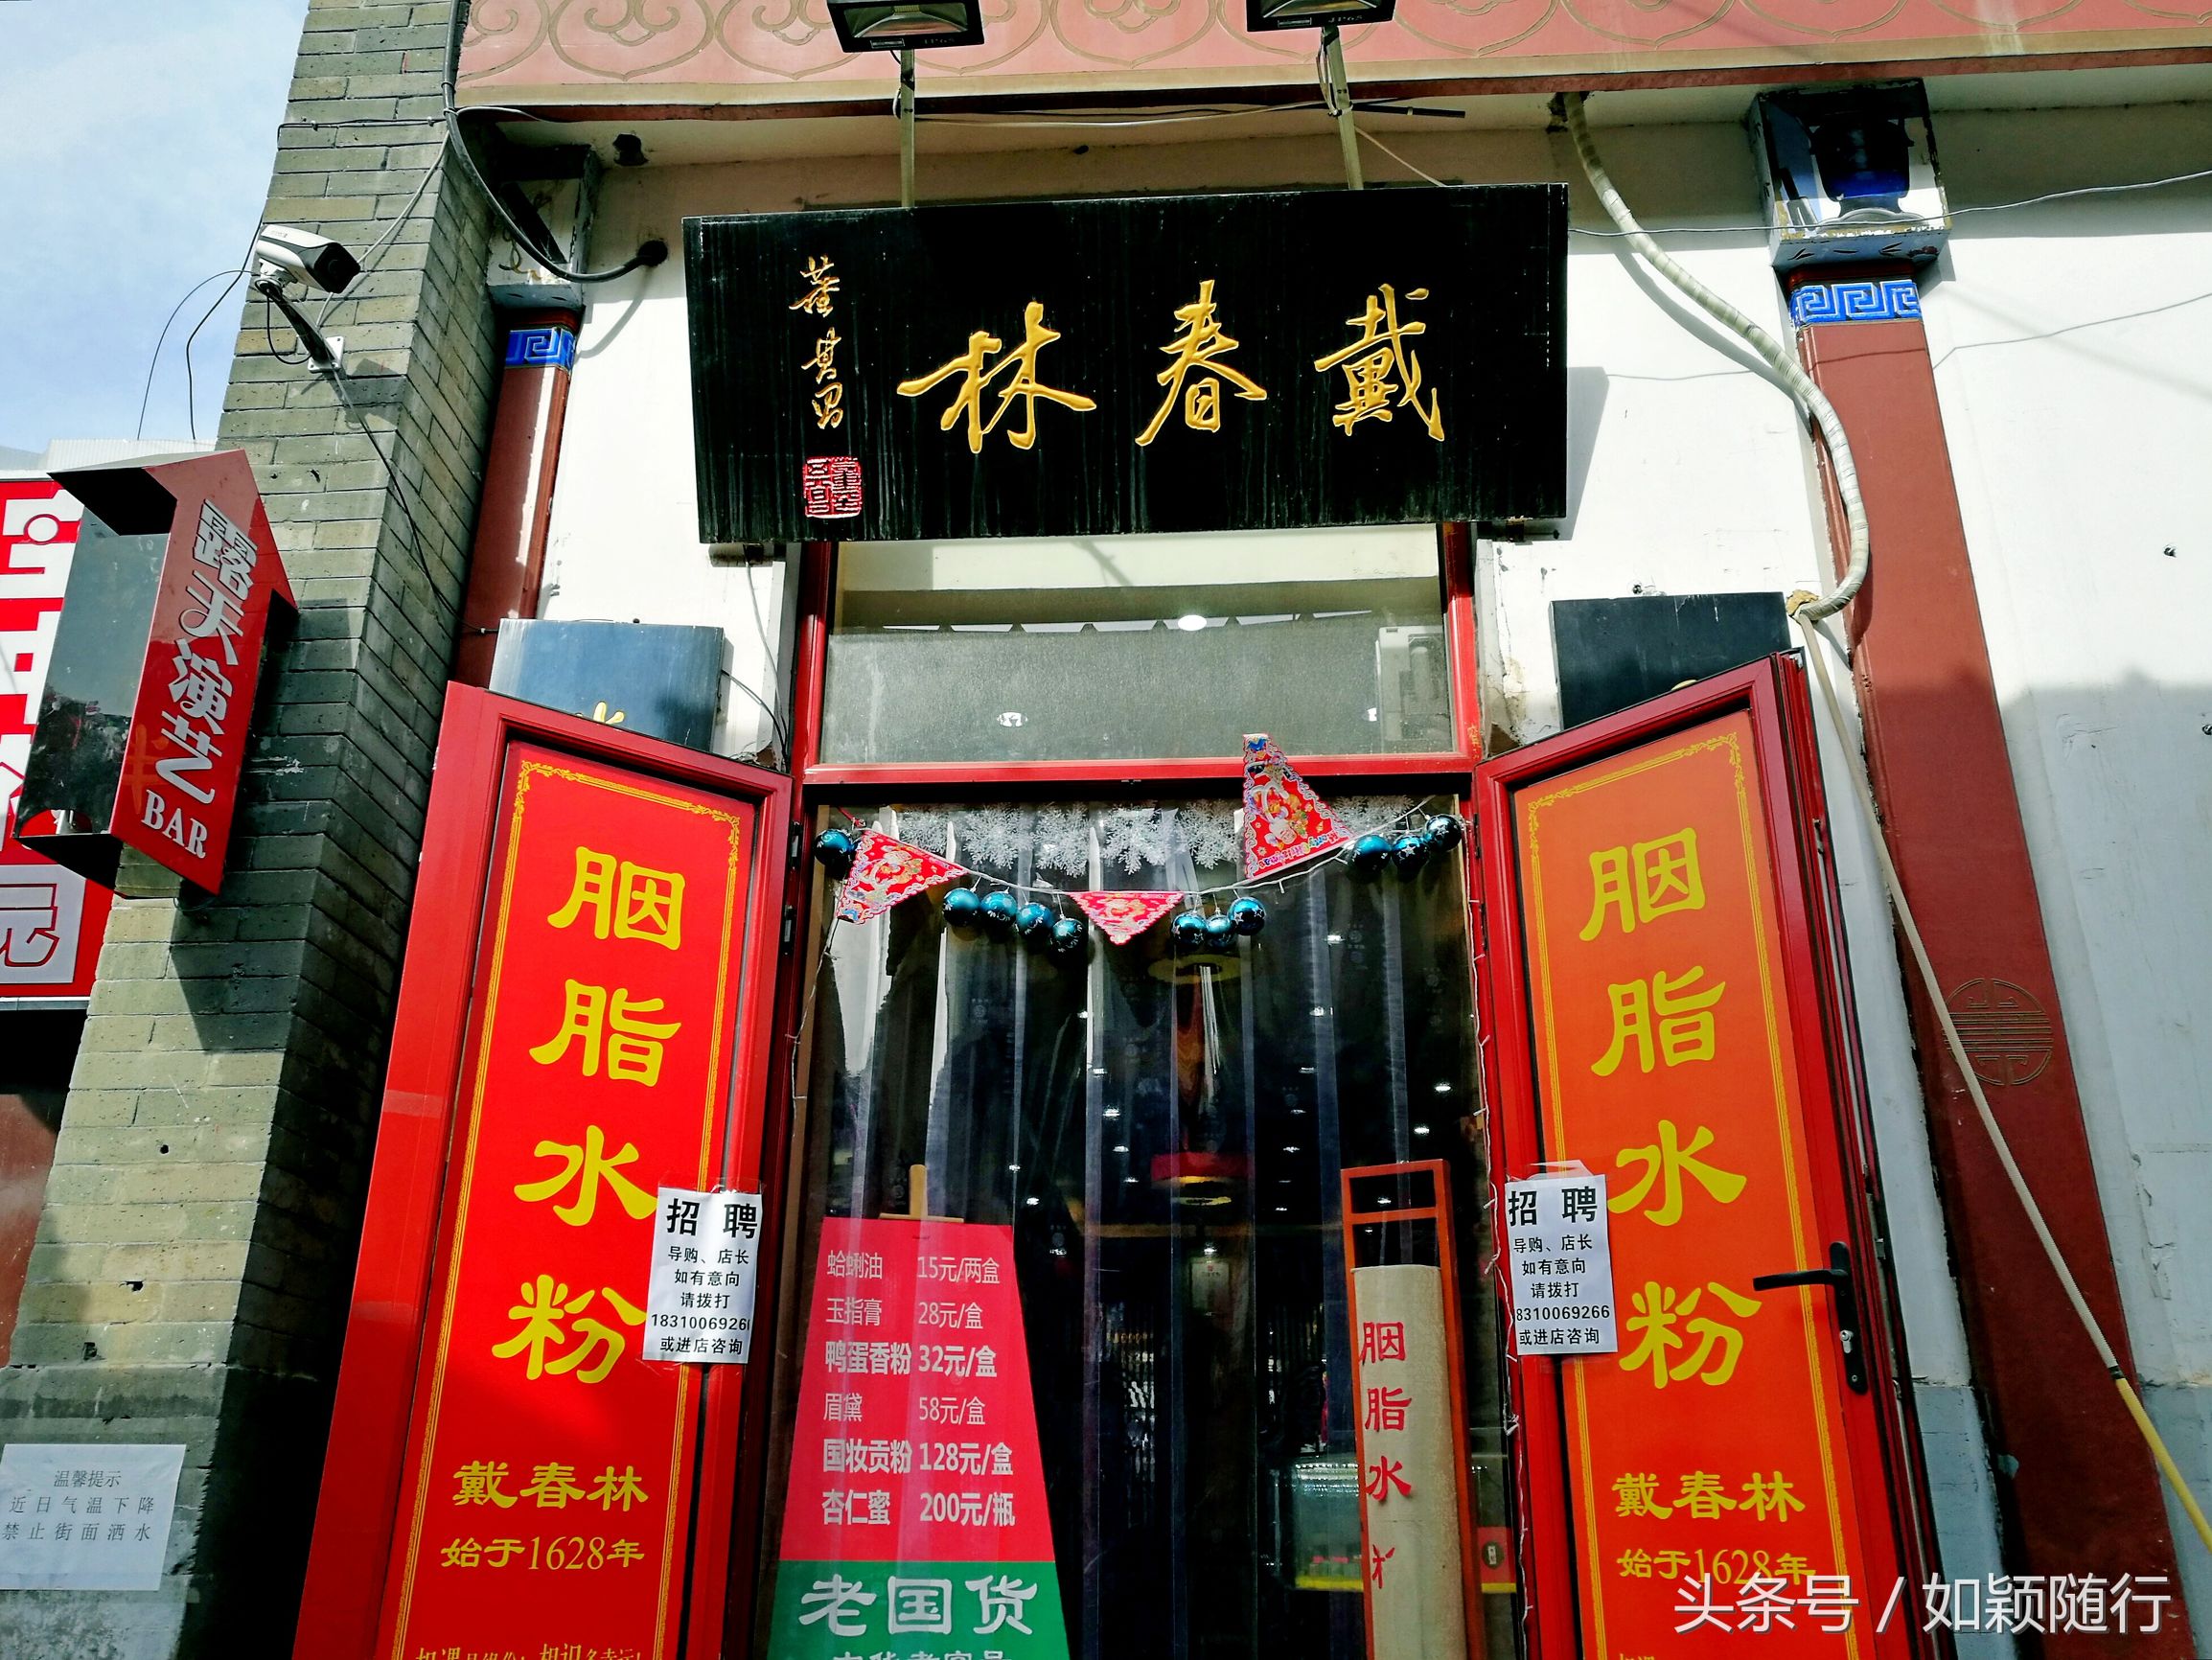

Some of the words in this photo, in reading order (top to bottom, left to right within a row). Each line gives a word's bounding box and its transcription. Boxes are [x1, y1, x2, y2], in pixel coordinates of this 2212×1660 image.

[896, 278, 1446, 453] 戴春林
[152, 497, 258, 805] 露天演艺
[141, 789, 208, 859] BAR
[491, 845, 686, 1384] 胭脂水粉
[1578, 827, 1763, 1390] 胭脂水粉
[666, 1198, 758, 1239] 招聘
[1508, 1186, 1598, 1227] 招聘
[668, 1245, 749, 1265] 导购、店长
[1513, 1233, 1593, 1254] 导购、店长
[674, 1269, 740, 1287] 如有意向
[916, 1257, 1001, 1284] 15元/两盒
[1522, 1257, 1586, 1276] 如有意向
[680, 1292, 731, 1309] 请拨打
[1531, 1280, 1579, 1299] 请拨打
[651, 1313, 750, 1331] 1831006926
[825, 1297, 882, 1326] 玉指膏
[918, 1302, 983, 1329] 28元/盒
[660, 1336, 743, 1355] 或进店咨询
[1519, 1327, 1600, 1346] 或进店咨询
[825, 1340, 912, 1375] 鸭蛋香粉
[918, 1345, 998, 1377] 32元/盒
[823, 1393, 863, 1423] 眉黛
[919, 1395, 986, 1425] 58元/盒
[823, 1439, 913, 1474] 国妆贡粉
[919, 1441, 1014, 1476] 128元/盒
[54, 1470, 122, 1487] 温馨提示
[451, 1461, 649, 1512] 戴春林
[9, 1496, 155, 1515] 近日气温下降
[821, 1488, 891, 1526] 杏仁蜜
[920, 1491, 1016, 1527] 200元/瓶
[1611, 1470, 1807, 1522] 戴春林
[440, 1535, 645, 1571] 始于1628年
[798, 1574, 1038, 1637] 老国货
